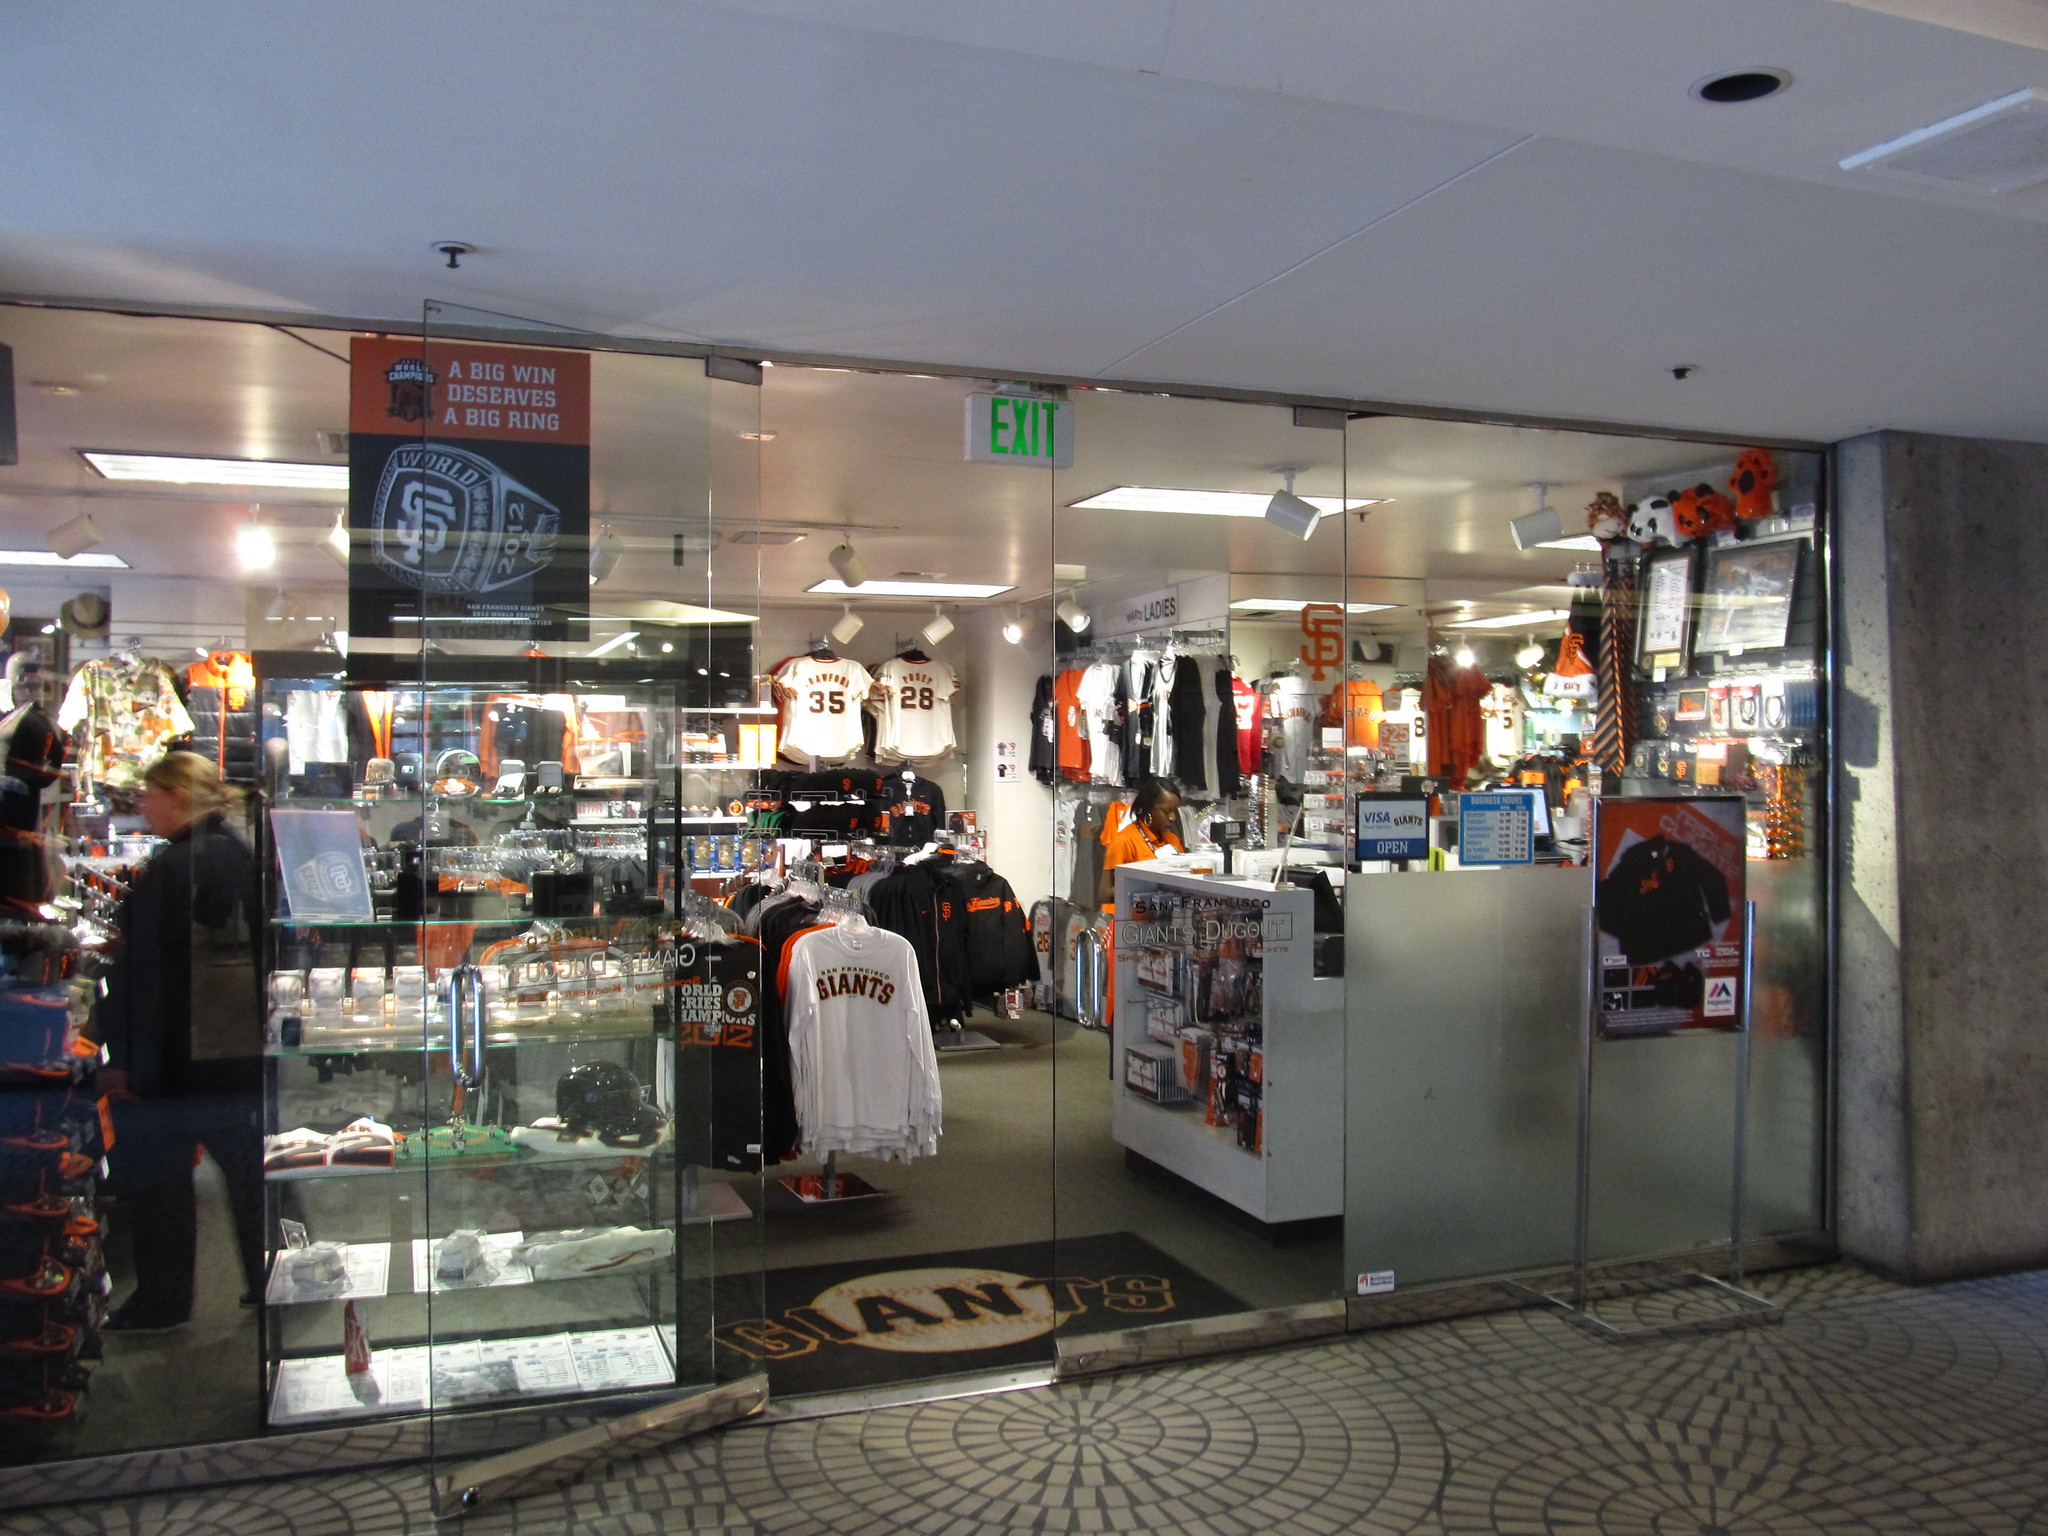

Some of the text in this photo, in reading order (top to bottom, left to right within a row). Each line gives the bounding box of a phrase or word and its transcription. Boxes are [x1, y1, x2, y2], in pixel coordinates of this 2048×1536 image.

[448, 361, 557, 384] A BIG WIN
[448, 384, 557, 408] DESERVES
[444, 407, 560, 431] A BIG RING
[991, 397, 1059, 457] EXIT
[401, 451, 480, 485] WORLD
[497, 503, 525, 574] 2012
[1144, 597, 1176, 622] LADIES
[806, 673, 850, 688] RAWFOR
[902, 672, 934, 685] POSEY
[809, 691, 846, 714] 35
[900, 686, 934, 710] 28
[1471, 796, 1500, 804] BUSINESS
[1364, 812, 1423, 826] VISA GIANTS
[1377, 841, 1408, 854] OPEN
[1135, 898, 1271, 914] SAN FRANCISCO
[1122, 919, 1285, 945] GIANTS DUGOUT
[821, 966, 890, 979] SAN FRANCISCO
[682, 984, 722, 996] ORLD
[816, 973, 895, 1005] GIANTS
[681, 996, 721, 1009] RIES
[682, 1008, 756, 1026] HAMPIONS
[681, 1023, 753, 1048] 2012
[707, 1275, 1176, 1360] GIANTS
